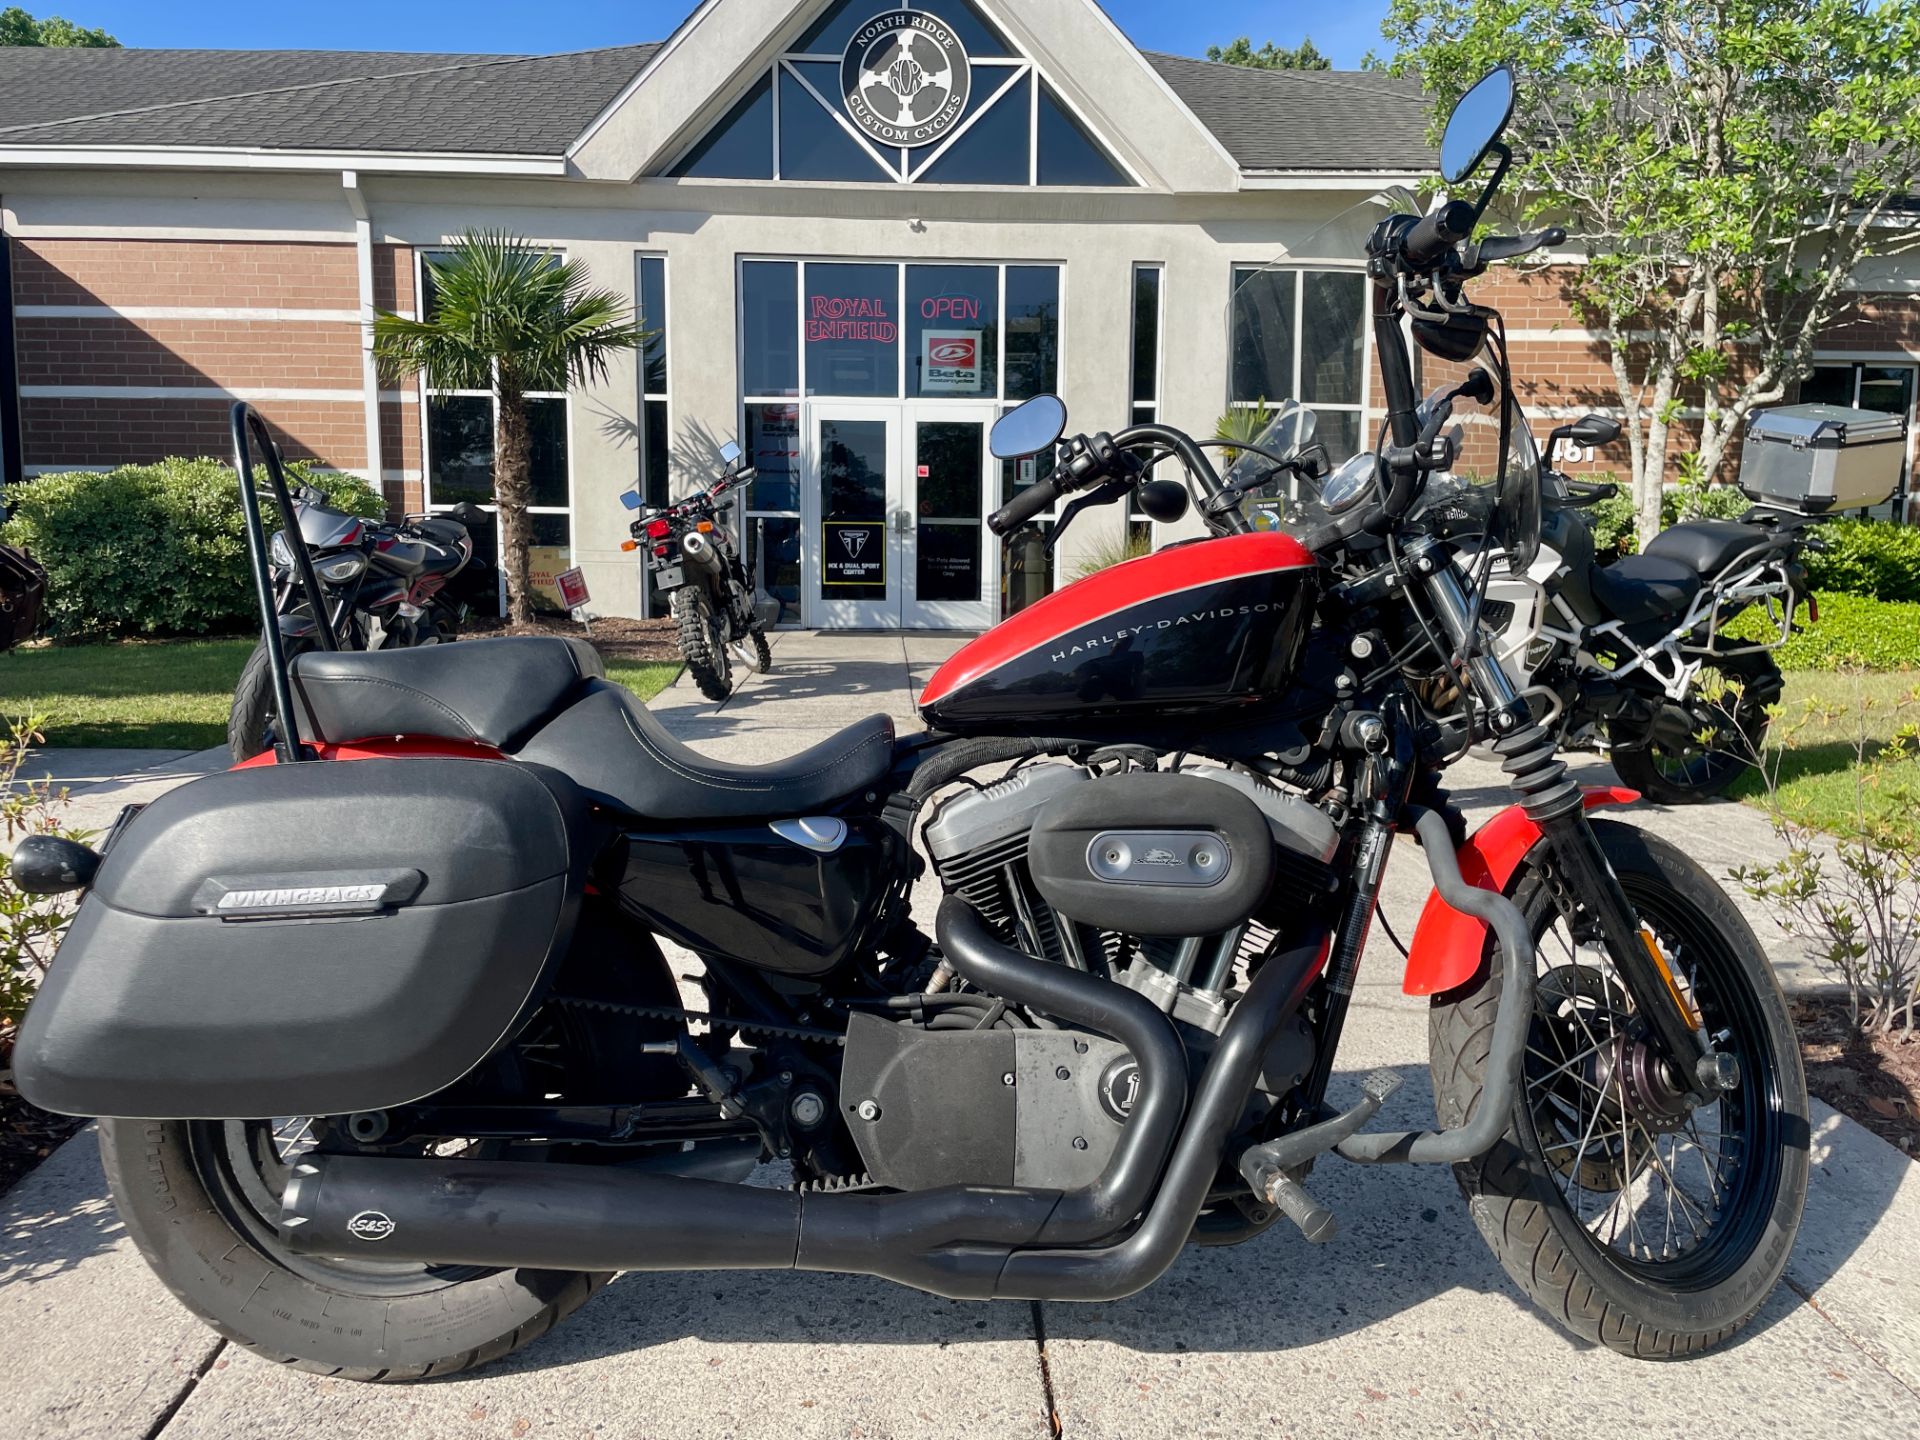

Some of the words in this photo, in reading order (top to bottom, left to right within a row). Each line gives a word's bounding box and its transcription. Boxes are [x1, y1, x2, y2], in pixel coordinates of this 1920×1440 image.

[857, 15, 906, 48] NORTH
[911, 15, 954, 49] RIDGE
[850, 94, 909, 141] CUSTOM
[914, 94, 961, 139] CYCLES
[811, 296, 887, 319] ROYAL
[921, 298, 979, 319] OPEN
[805, 320, 897, 343] ENFIELD
[928, 369, 975, 378] Beta
[1051, 602, 1285, 662] HARLEY-DAVIDSON
[231, 886, 373, 907] VIKINGBAGS
[354, 1219, 388, 1232] S&S
